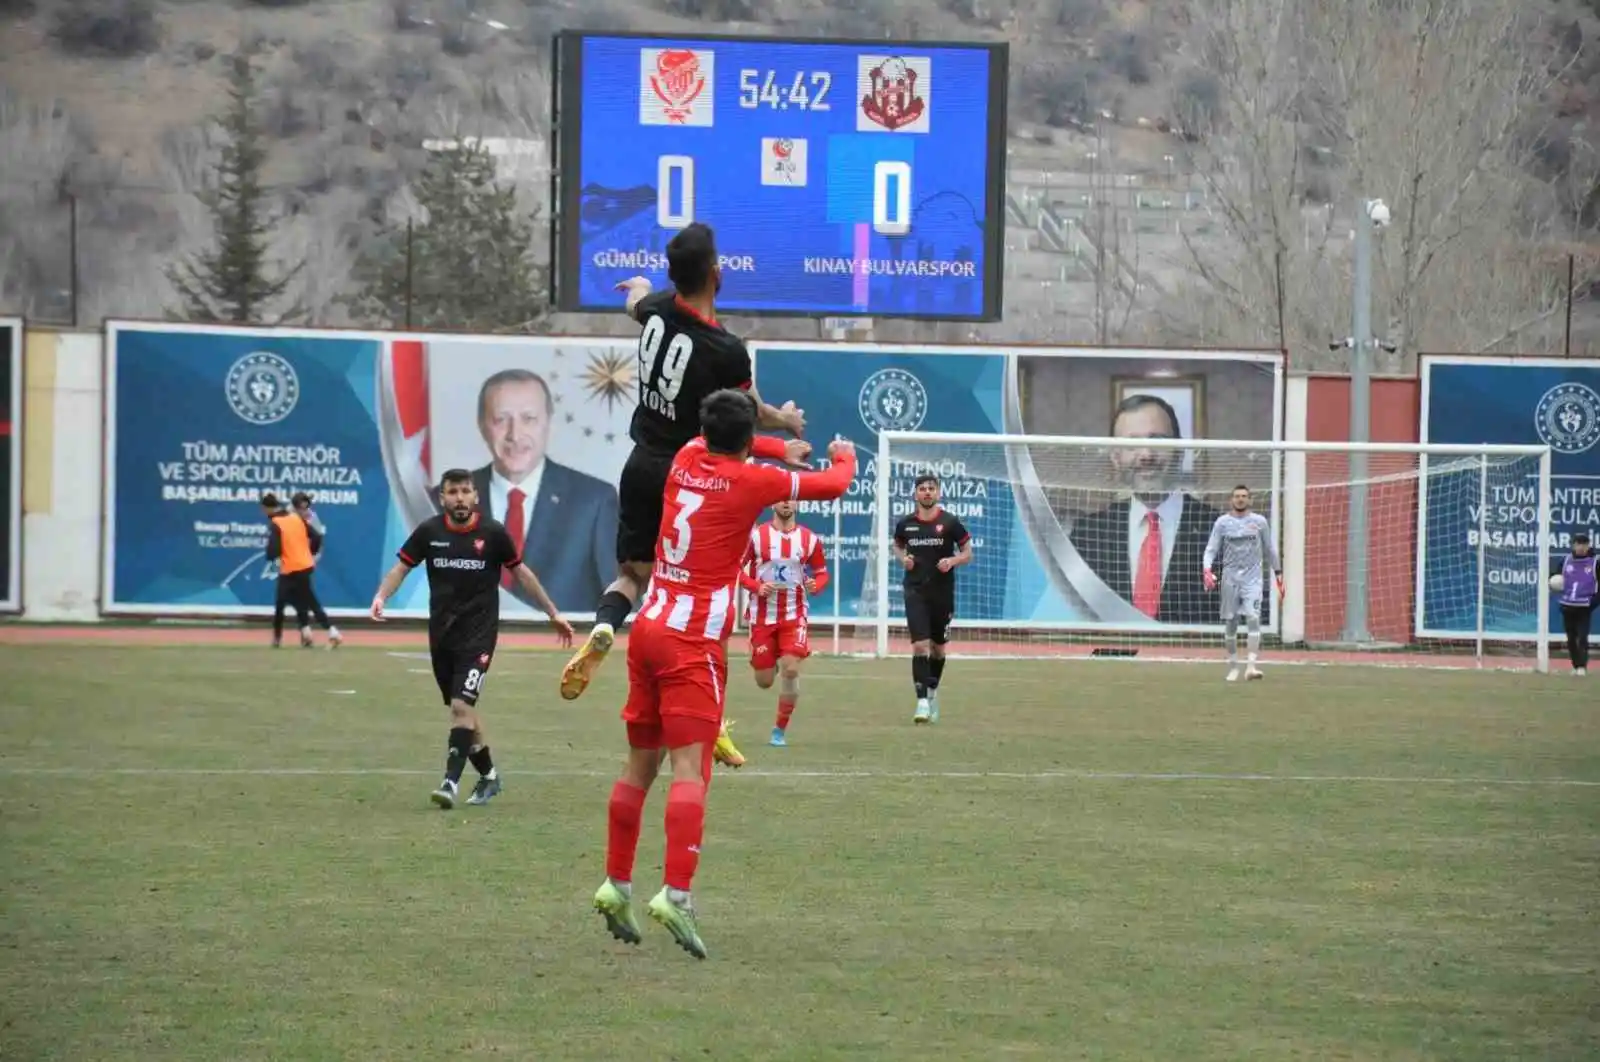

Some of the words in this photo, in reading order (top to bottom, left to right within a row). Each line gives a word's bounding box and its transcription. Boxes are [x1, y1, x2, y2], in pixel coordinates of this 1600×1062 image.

[740, 69, 831, 111] 54:42
[657, 155, 694, 229] 0
[873, 161, 911, 235] 0
[593, 248, 755, 273] GÜMÜŞHPOR
[804, 257, 855, 274] KINAY
[861, 259, 975, 277] BULVARSPOR
[640, 314, 693, 402] 99
[181, 440, 228, 462] TÜM
[232, 442, 341, 465] ANTRENÖR
[158, 461, 184, 481] VE
[188, 461, 362, 486] SPORCULARIMIZA
[864, 457, 967, 479] ATRENÖR
[163, 484, 260, 504] BAŞARILAR
[262, 485, 358, 505] İLİORUM
[1492, 482, 1535, 504] TÜM
[798, 500, 887, 518] BAŞARILA
[663, 488, 705, 565] 3
[1467, 530, 1571, 549] BAŞARIAR
[1488, 568, 1538, 585] GÜMÜ
